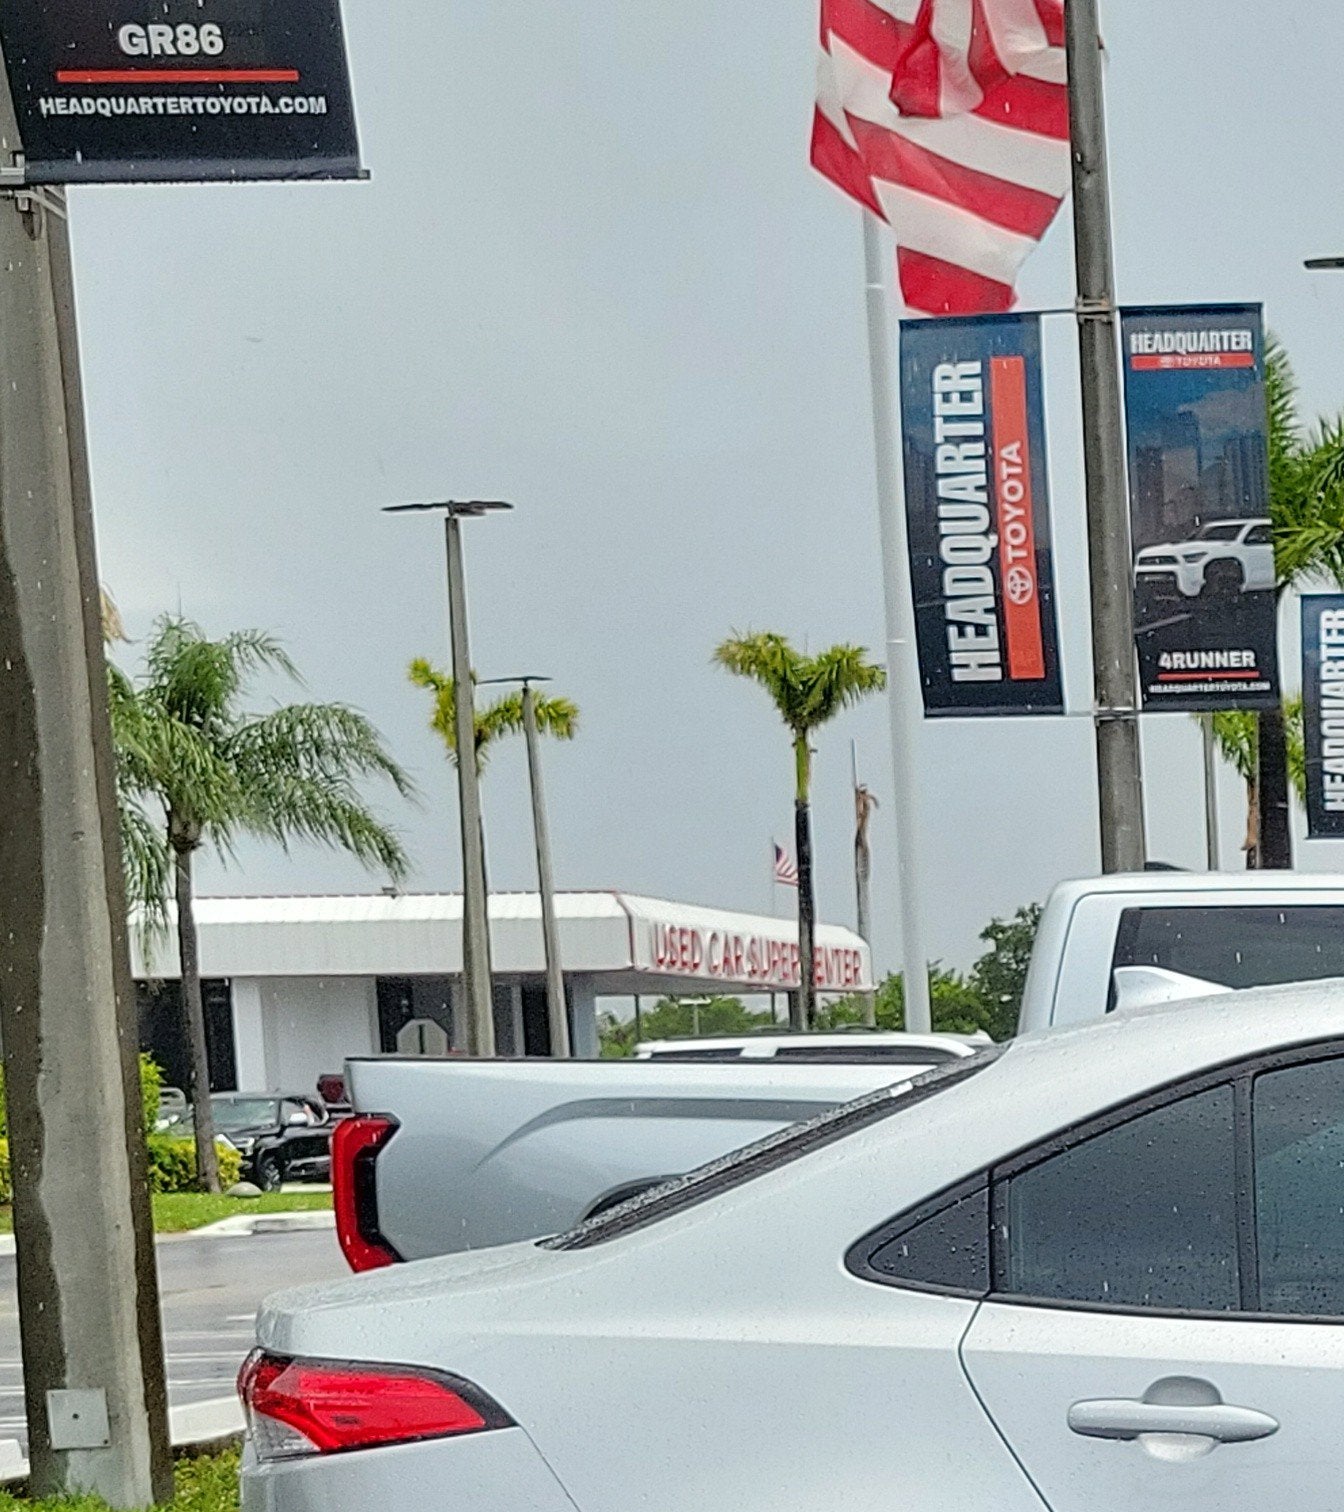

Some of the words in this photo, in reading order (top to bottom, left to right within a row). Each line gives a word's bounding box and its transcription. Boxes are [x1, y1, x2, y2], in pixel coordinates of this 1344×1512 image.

[118, 23, 224, 56] GR86
[39, 96, 327, 117] HEADQUARTERTOYOTA.COM
[1130, 329, 1253, 355] HEADQUARTER
[1001, 440, 1029, 562] TOYOTA
[931, 359, 1003, 682] HEADQUARTER
[1158, 650, 1256, 669] 4RUNNER
[655, 922, 702, 972] USED
[706, 928, 746, 978] CAR
[746, 934, 802, 986] SUPER
[809, 944, 864, 988] ENTER
